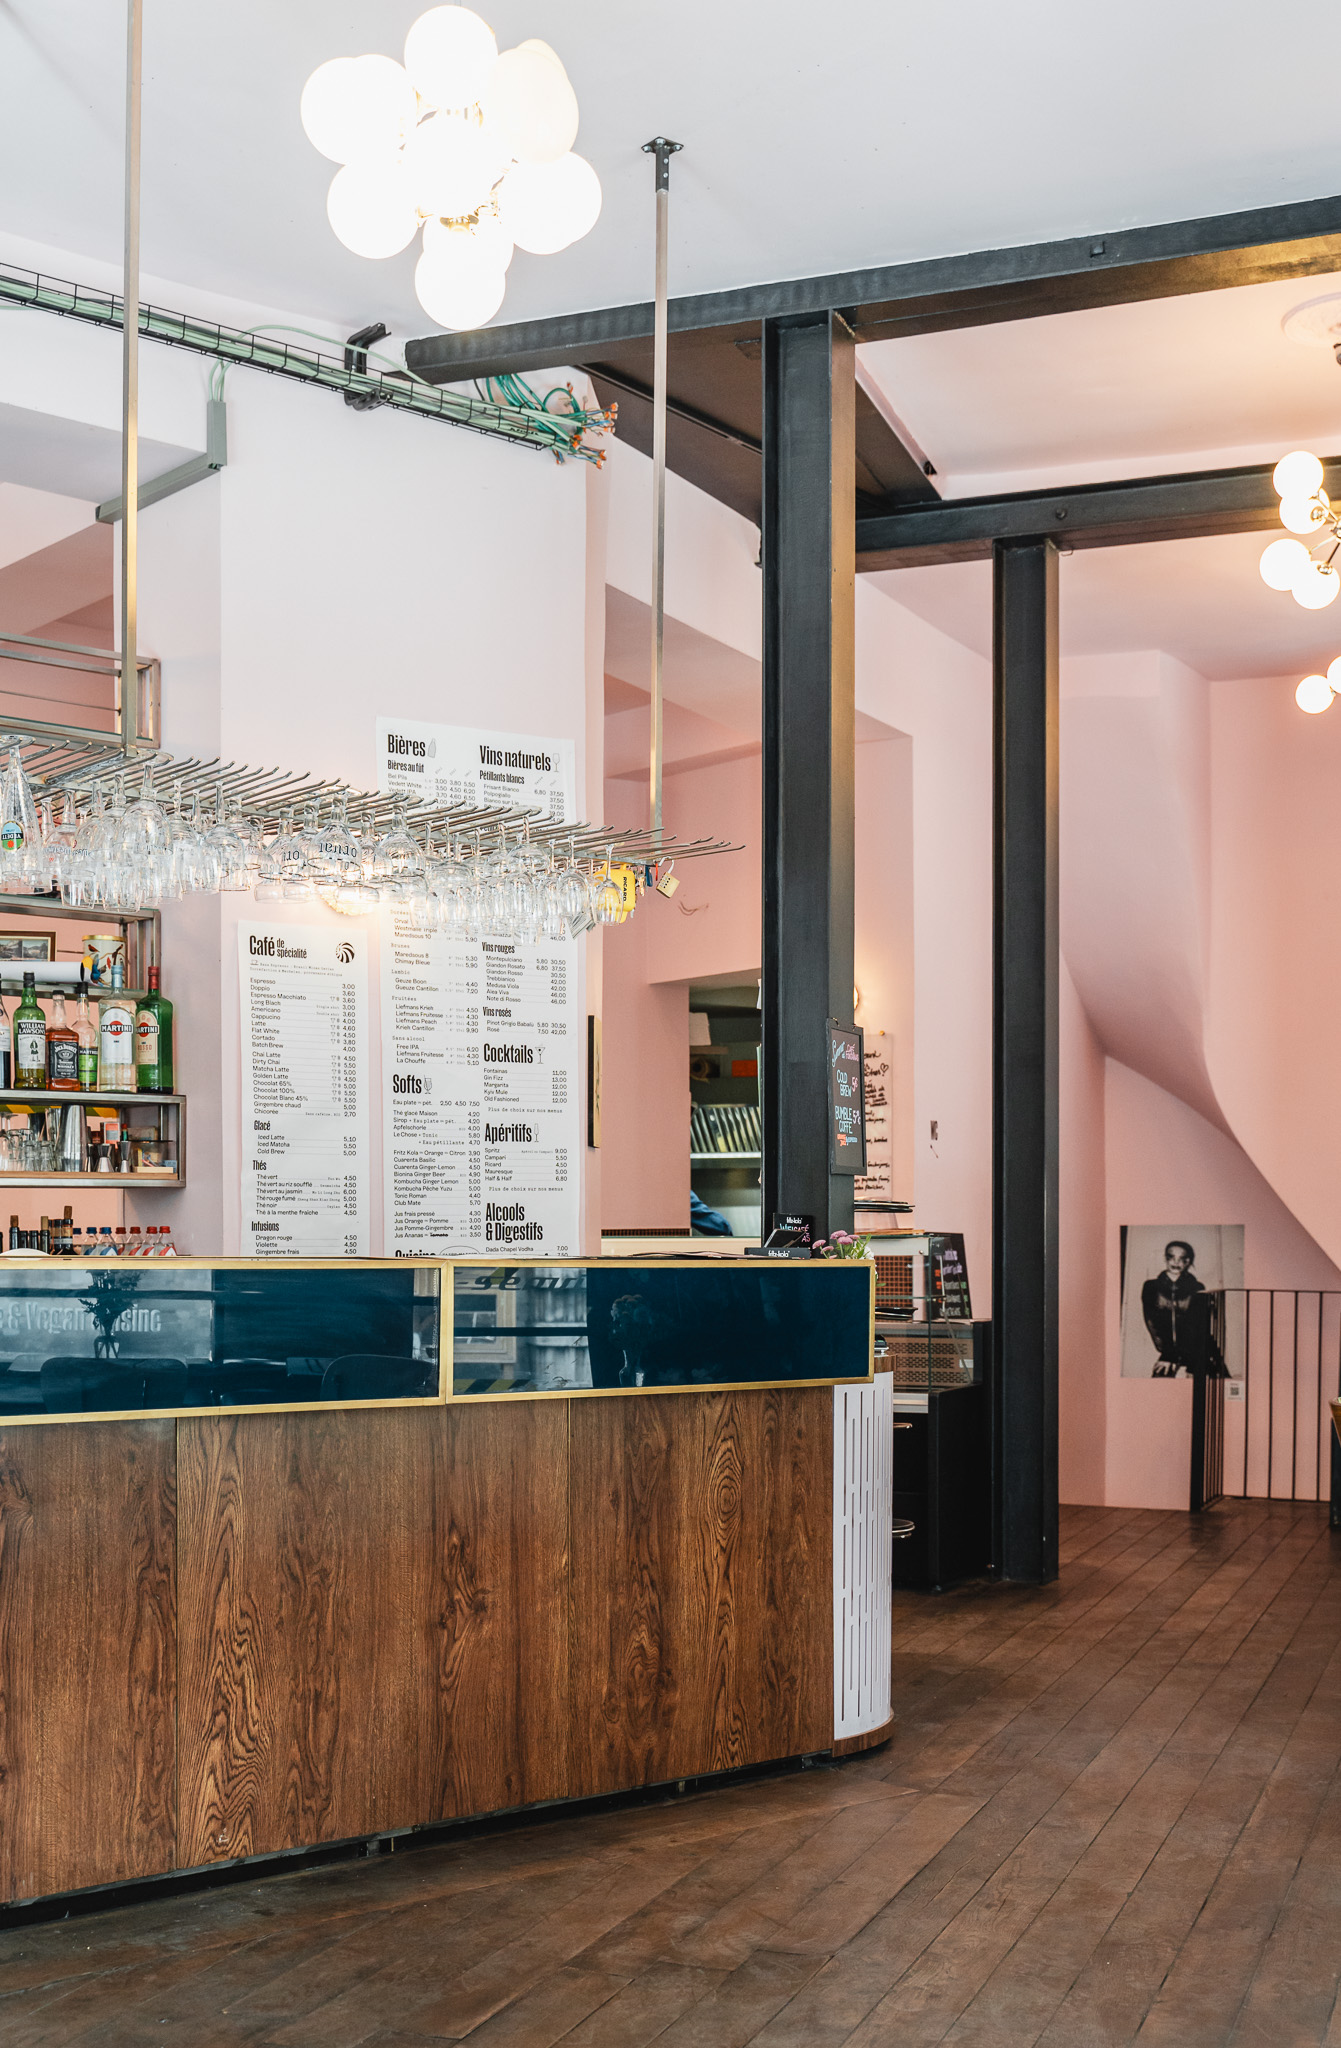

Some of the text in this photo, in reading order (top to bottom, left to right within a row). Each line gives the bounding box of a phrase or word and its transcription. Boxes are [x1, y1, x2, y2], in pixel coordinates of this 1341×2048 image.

[388, 734, 425, 756] Bières
[480, 745, 551, 771] Vins naturels
[388, 760, 407, 771] Bières
[480, 770, 505, 782] Pétillants
[506, 773, 524, 784] blancs
[250, 935, 275, 956] Café
[277, 938, 284, 948] de
[482, 942, 515, 954] Vins rouges
[277, 949, 307, 958] spécialité
[483, 1006, 511, 1017] Vins rosés
[484, 1043, 533, 1063] Cocktails
[836, 1069, 848, 1083] COLD
[393, 1074, 422, 1094] Softs
[840, 1085, 852, 1097] BREW
[254, 1120, 270, 1130] Glacé
[485, 1123, 532, 1144] Apéritifs
[253, 1160, 266, 1170] Thés
[486, 1203, 524, 1221] Alcools
[252, 1221, 279, 1232] Infusions
[486, 1222, 543, 1243] & Digestifs
